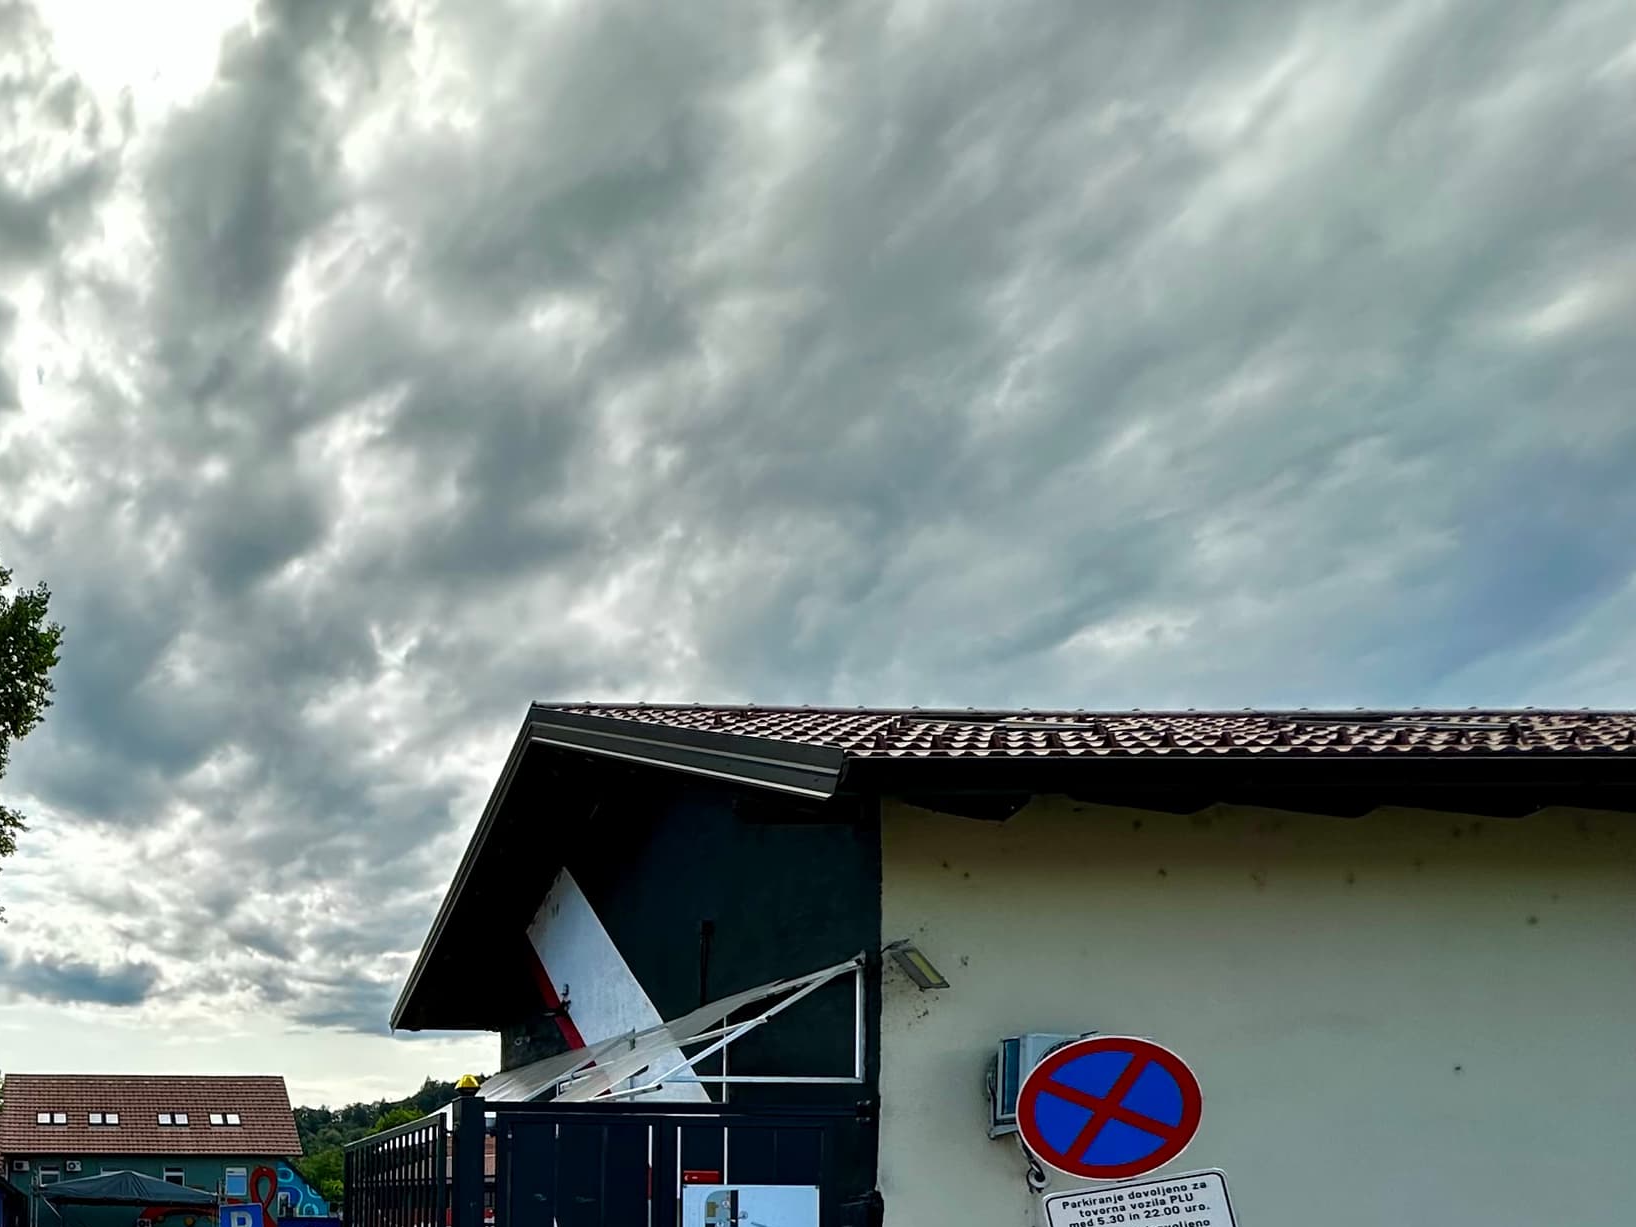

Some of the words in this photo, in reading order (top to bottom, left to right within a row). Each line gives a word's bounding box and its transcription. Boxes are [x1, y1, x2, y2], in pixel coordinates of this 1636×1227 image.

[1061, 1194, 1124, 1210] Parkiranje
[1127, 1184, 1188, 1200] dovoljeno
[1191, 1182, 1207, 1190] za
[1079, 1205, 1126, 1218] tovorna
[1130, 1198, 1166, 1210] vozila
[1169, 1192, 1194, 1204] PLU
[1097, 1214, 1125, 1226] 5.30
[1129, 1212, 1140, 1221] in
[1143, 1206, 1180, 1219] 22.00
